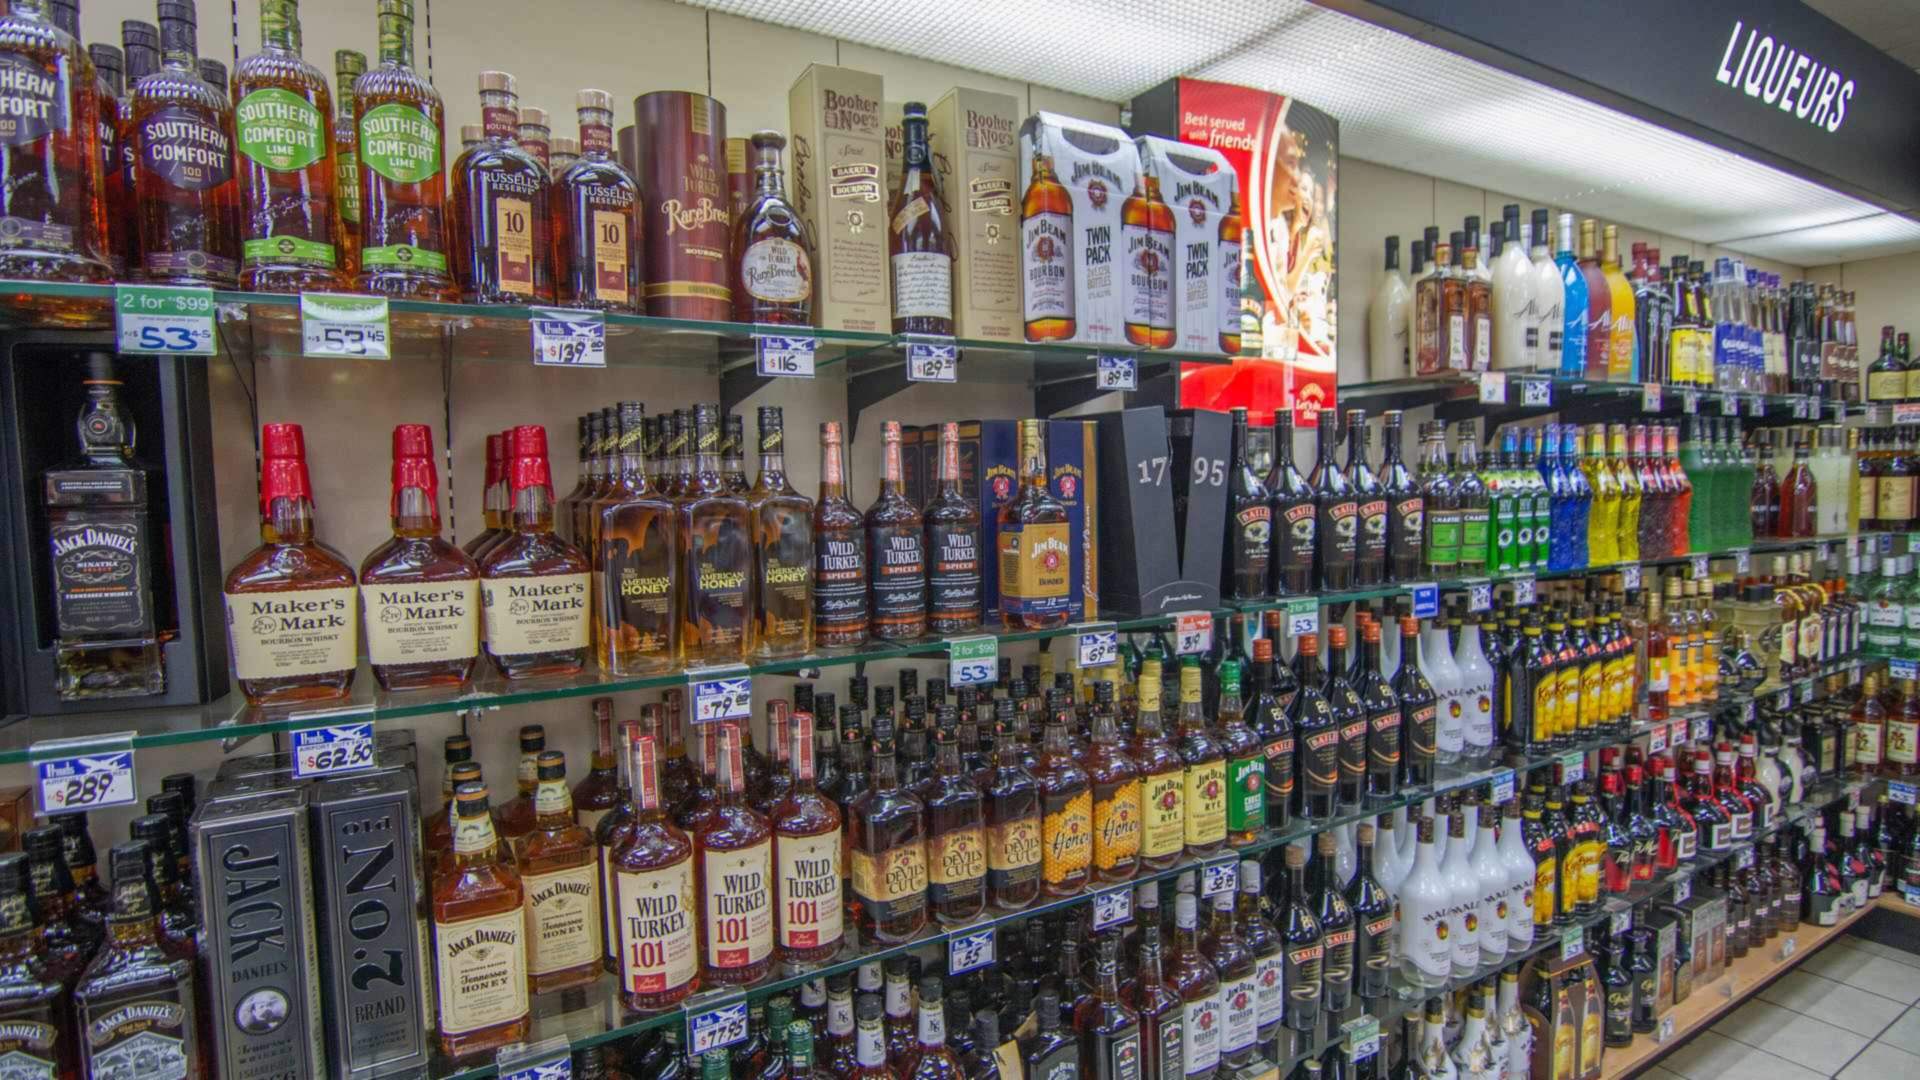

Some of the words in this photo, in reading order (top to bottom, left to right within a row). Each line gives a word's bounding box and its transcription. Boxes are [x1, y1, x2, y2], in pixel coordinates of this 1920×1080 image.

[1715, 20, 1855, 132] LIQUEURS
[824, 89, 878, 114] Booker
[240, 102, 318, 129] SOUTHERN
[838, 110, 878, 132] Noe's
[967, 110, 1013, 131] Booker
[1185, 112, 1206, 126] Best
[1210, 116, 1245, 132] served
[146, 122, 228, 150] SOUTHERN
[243, 127, 318, 148] COMFORT
[363, 117, 437, 144] SOUTHERN
[978, 129, 1013, 148] Noe's
[1189, 130, 1207, 141] with
[1209, 130, 1257, 150] friends
[152, 145, 226, 170] COMFORT
[266, 145, 294, 155] LIME
[368, 140, 434, 163] COMFORT
[389, 157, 416, 168] LIME
[837, 166, 872, 176] BARREL
[482, 171, 540, 191] RUSSELL'S
[1072, 161, 1091, 183] JIM
[1092, 162, 1123, 192] BEAM
[492, 182, 533, 195] RESERVE
[580, 185, 634, 202] RUSSELL'S
[837, 184, 873, 194] BOURBON
[1174, 182, 1192, 202] JIM
[1193, 181, 1219, 209] BEAM
[590, 196, 630, 208] RESERVE
[504, 211, 525, 233] 10
[601, 224, 619, 243] 10
[1026, 226, 1040, 248] JIM
[1040, 219, 1066, 244] BEAM
[1086, 226, 1111, 243] TWIN
[1128, 236, 1143, 253] JIM
[1144, 234, 1170, 259] BEAM
[1186, 242, 1209, 260] TWIN
[1086, 247, 1111, 266] PACK
[1030, 265, 1065, 281] BOURBON
[1186, 261, 1209, 280] PACK
[1131, 274, 1168, 290] BOURBON
[123, 294, 134, 308] 2
[141, 294, 164, 309] for
[176, 295, 209, 311] $99
[139, 326, 198, 350] 53
[324, 328, 367, 354] 53
[1138, 456, 1167, 487] 17
[1194, 457, 1225, 487] 95
[54, 533, 85, 556] JACK
[86, 528, 137, 555] DANIEL'S
[828, 541, 854, 555] WILD
[890, 536, 916, 550] WILD
[947, 534, 972, 547] WILD
[1032, 541, 1048, 558] JIM
[1048, 537, 1068, 553] BEAM
[821, 555, 860, 571] TURKEY
[884, 550, 920, 564] TURKEY
[941, 547, 976, 561] TURKEY
[700, 571, 745, 582] AMERICAN
[766, 566, 808, 576] AMERICAN
[766, 572, 805, 583] HONEY
[825, 572, 857, 580] SPICED
[508, 582, 585, 598] Maker's
[621, 584, 669, 596] HONEY
[622, 576, 670, 588] AMERICAN
[699, 578, 742, 590] HONEY
[251, 598, 345, 615] Maker's
[379, 590, 465, 605] Maker's
[531, 597, 585, 612] Mark
[405, 605, 464, 620] Mark
[280, 614, 345, 632] Mark
[261, 636, 303, 646] BOURBON
[305, 634, 340, 643] WHISKY
[954, 645, 961, 656] 2
[962, 643, 975, 655] for
[959, 665, 988, 682] 53
[1196, 773, 1209, 789] JIM
[1235, 765, 1250, 782] JIM
[1152, 785, 1166, 800] JIM
[1204, 801, 1221, 811] RYE
[1161, 812, 1177, 822] RYE
[795, 859, 830, 879] WILD
[724, 872, 760, 895] WILD
[786, 875, 836, 898] TURKEY
[221, 844, 287, 963] JACK
[531, 888, 554, 907] JACK
[555, 882, 591, 897] DANIEL'S
[714, 888, 766, 915] TURKEY
[636, 894, 678, 918] WILD
[788, 900, 818, 925] 101
[544, 924, 584, 940] HONEY
[628, 911, 686, 940] TURKEY
[717, 916, 748, 944] 101
[448, 935, 475, 957] JACK
[475, 929, 516, 946] DANIEL'S
[631, 940, 666, 968] 101
[232, 960, 289, 983] DANIELS
[460, 969, 508, 985] Tennessee
[462, 977, 508, 994] HONEY
[1226, 986, 1238, 1001] JIM
[1239, 982, 1255, 991] BEAM
[100, 1013, 126, 1033] JACK
[126, 1005, 171, 1019] DANIEL'S
[355, 995, 406, 1024] BRAND
[1191, 1004, 1204, 1021] JIM
